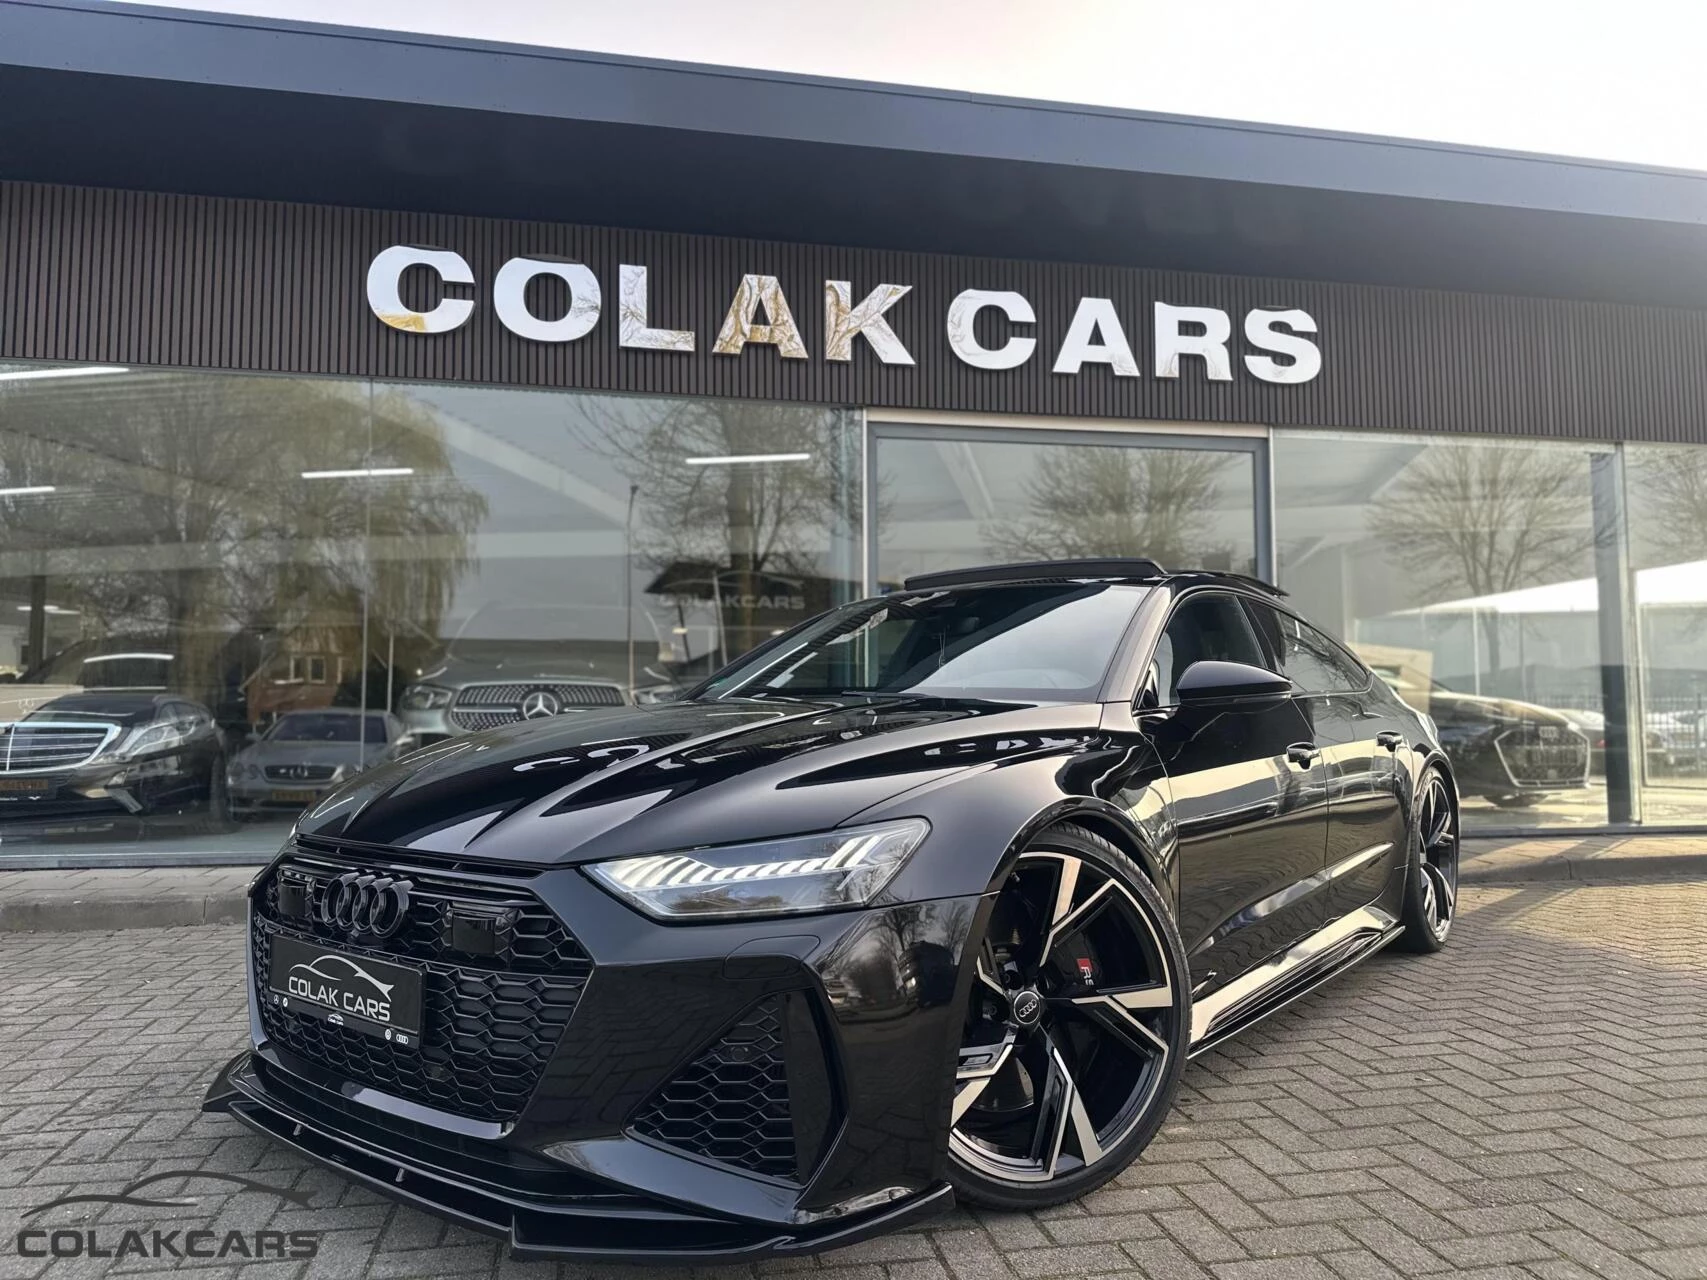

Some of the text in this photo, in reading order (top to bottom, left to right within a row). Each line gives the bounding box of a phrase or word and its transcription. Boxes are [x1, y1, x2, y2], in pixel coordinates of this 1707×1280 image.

[366, 244, 1322, 385] COLAK CARS
[288, 976, 390, 1022] COLAK CARS
